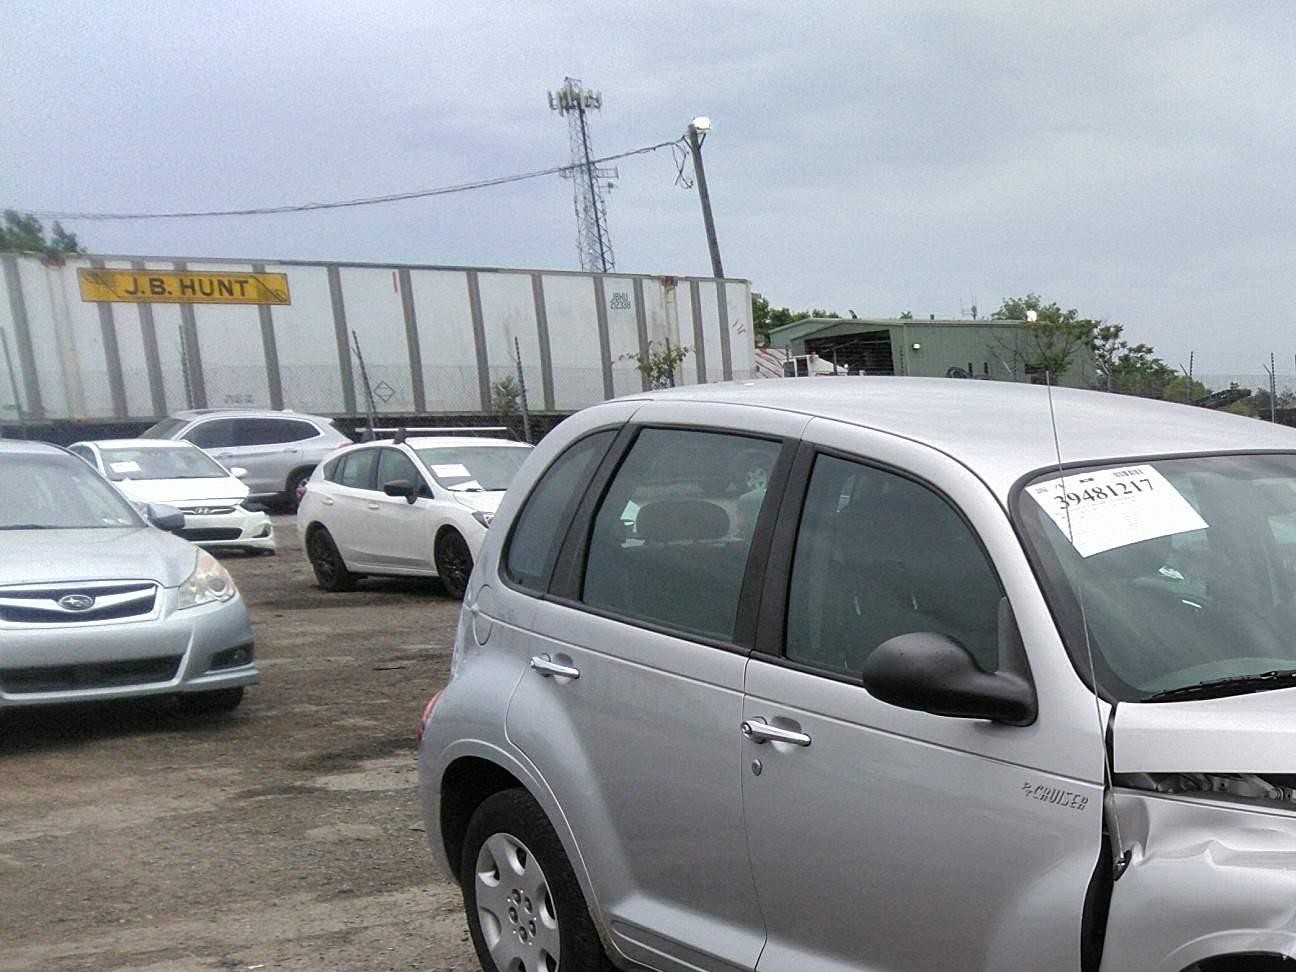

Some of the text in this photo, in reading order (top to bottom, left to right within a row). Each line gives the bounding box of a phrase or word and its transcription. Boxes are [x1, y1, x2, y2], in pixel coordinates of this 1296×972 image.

[124, 276, 249, 297] J.B. HUNT
[1053, 478, 1154, 510] 39481217
[1033, 784, 1089, 811] CRUISER
